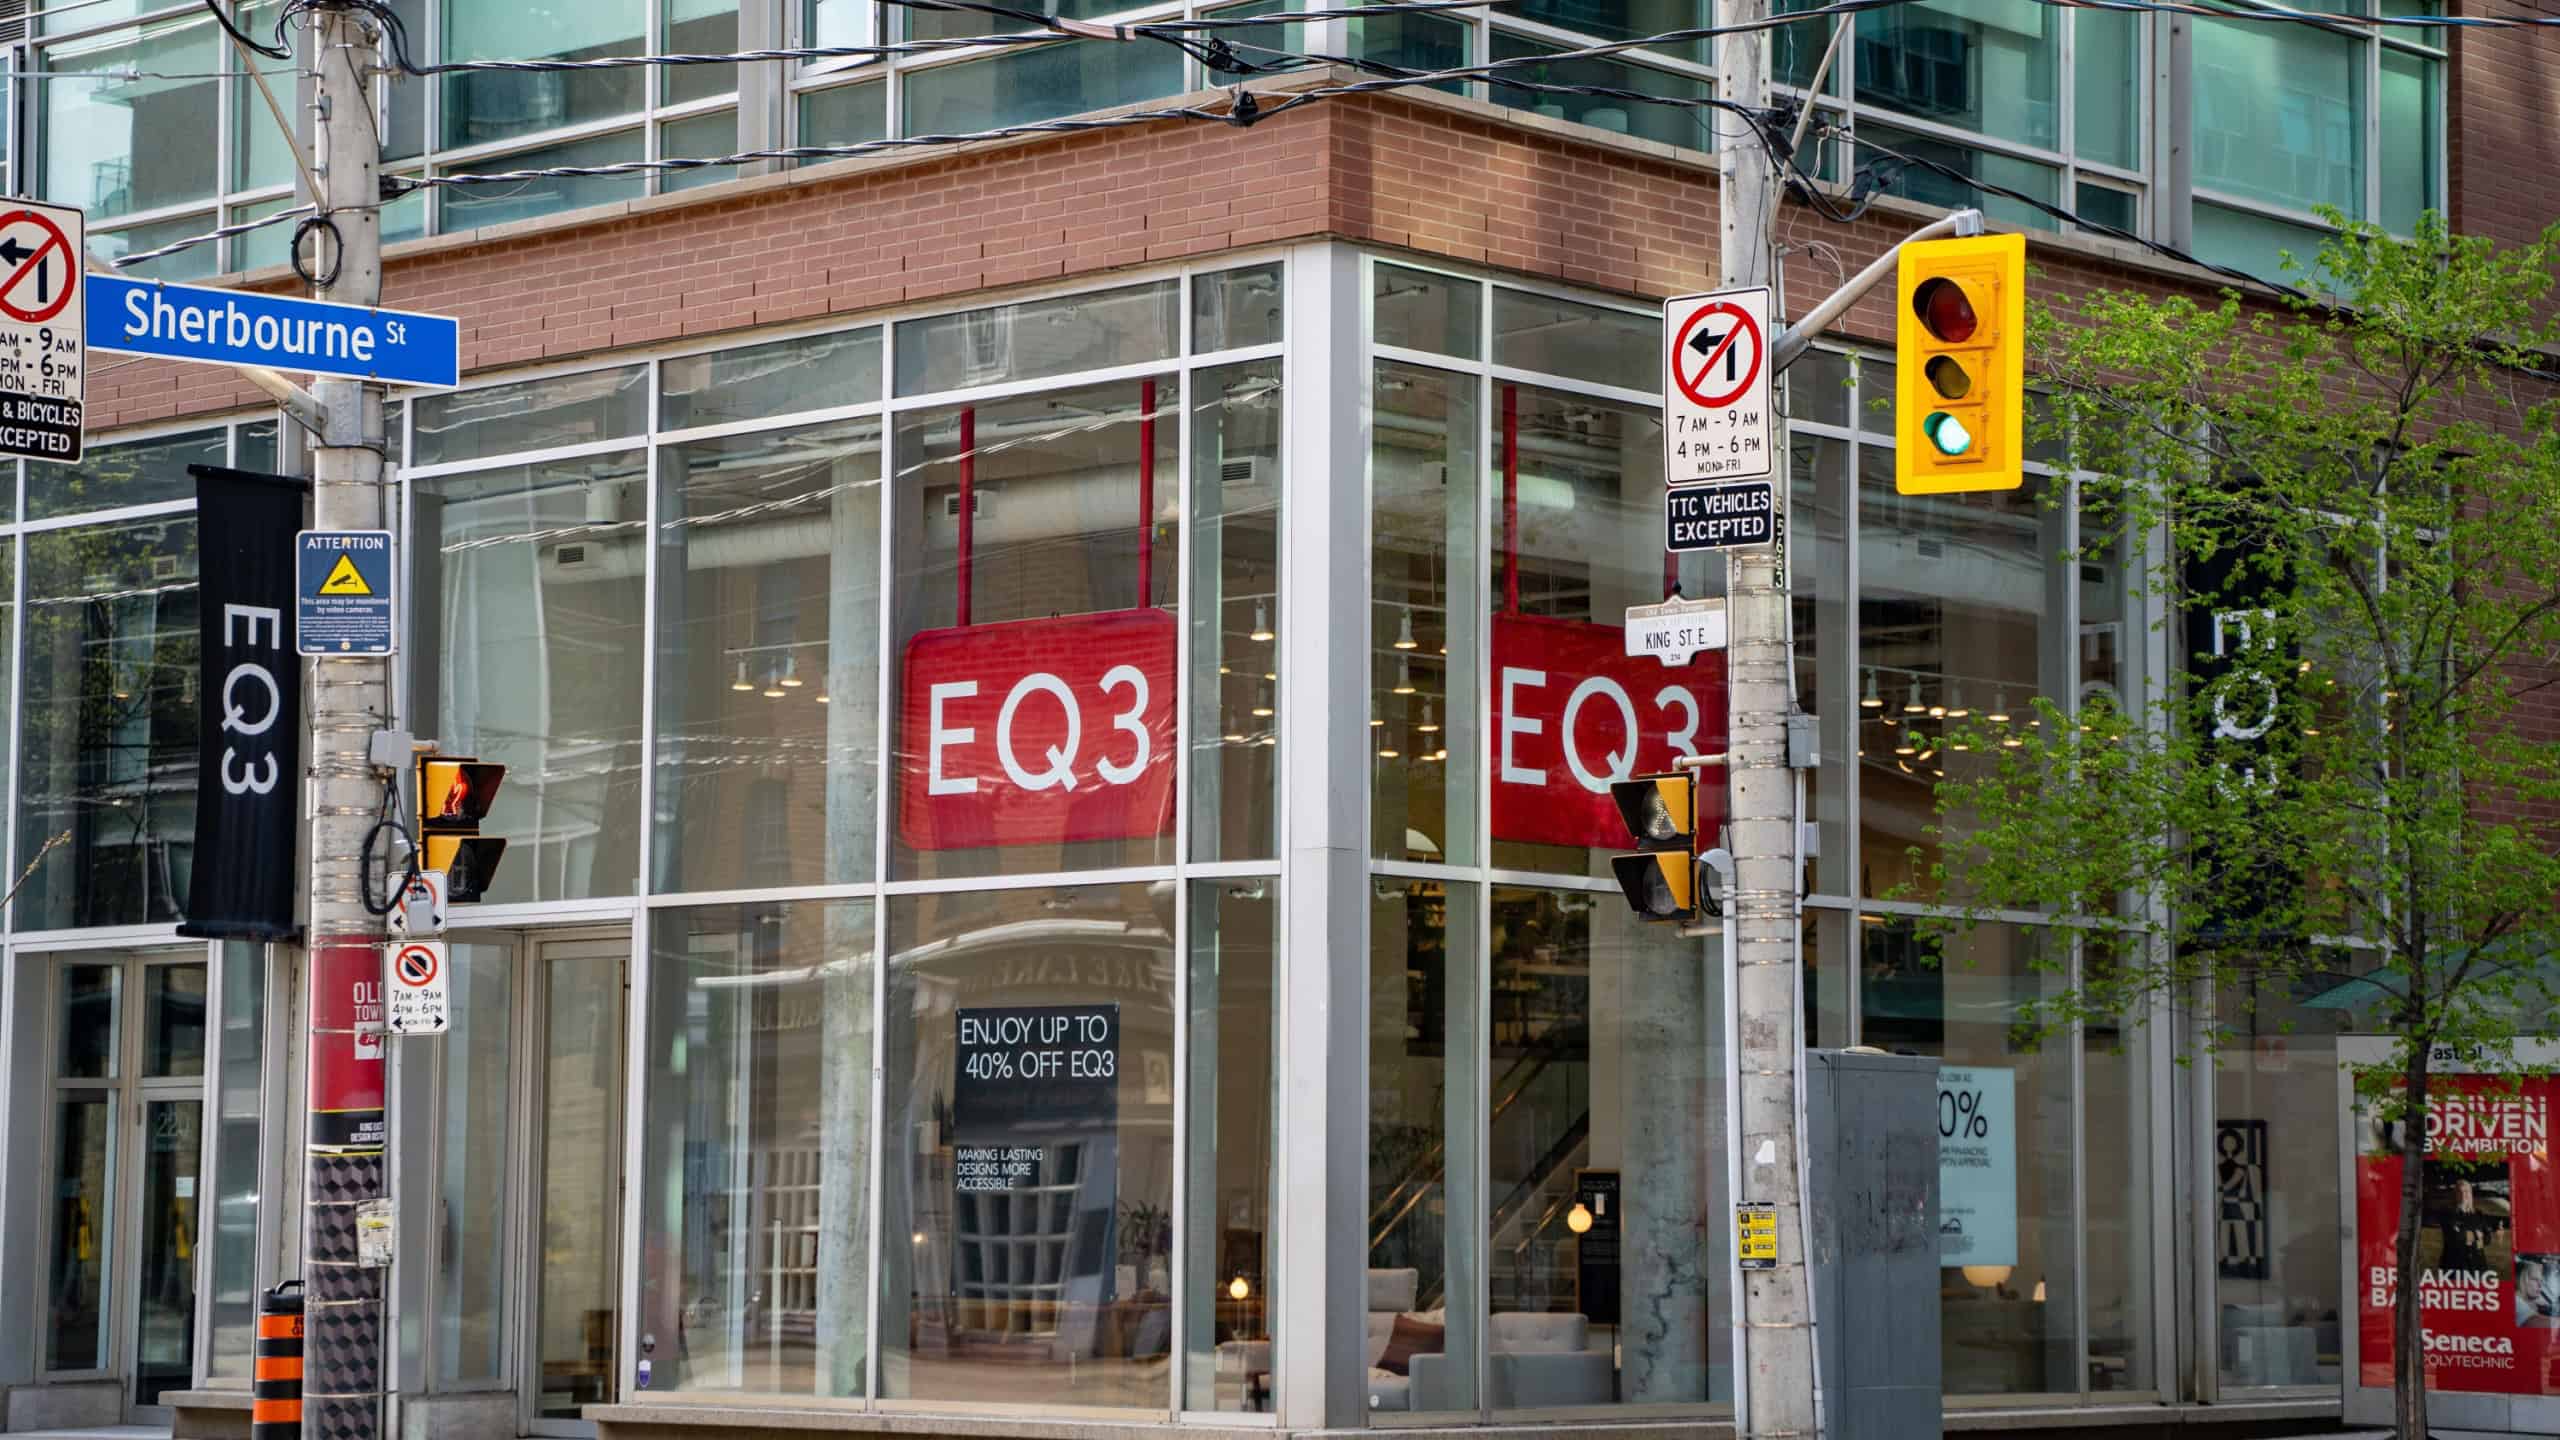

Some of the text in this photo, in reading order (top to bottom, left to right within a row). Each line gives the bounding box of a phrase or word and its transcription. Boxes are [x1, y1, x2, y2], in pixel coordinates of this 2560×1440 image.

[124, 288, 407, 361] Sherbourne St
[40, 327, 52, 351] 9
[55, 338, 76, 353] AM
[1, 358, 20, 373] PM
[41, 354, 54, 377] 6
[58, 364, 77, 379] PM
[42, 379, 65, 395] FRI
[2, 400, 80, 427] & BICYCLES
[1677, 415, 1686, 433] 7
[1691, 418, 1707, 432] AM
[1728, 409, 1737, 427] 9
[1743, 412, 1758, 426] AM
[1677, 440, 1686, 459] 4
[1694, 443, 1710, 456] PM
[1730, 435, 1739, 453] 6
[1744, 437, 1760, 452] PM
[1670, 491, 1769, 517] TTC VEHICLES
[1674, 516, 1764, 541] EXCEPTED
[307, 537, 384, 550] ATTENTION
[1646, 631, 1670, 649] KING
[221, 602, 281, 796] EQ3
[928, 664, 1151, 796] EQ3
[1501, 666, 1700, 794] EQ3
[961, 1015, 1107, 1044] ENJOY UP TO
[965, 1050, 1115, 1079] 40% OFF EQ3
[2425, 1112, 2547, 1138] DRIVEN
[957, 1149, 1043, 1160] MAKING LASTING
[2423, 1137, 2547, 1153] BY AMBITION
[957, 1163, 1032, 1175] DESIGNS MORE
[956, 1177, 1014, 1190] ACCESSIBLE
[2371, 1267, 2499, 1289] BRAKING
[2422, 1328, 2513, 1354] Seneca
